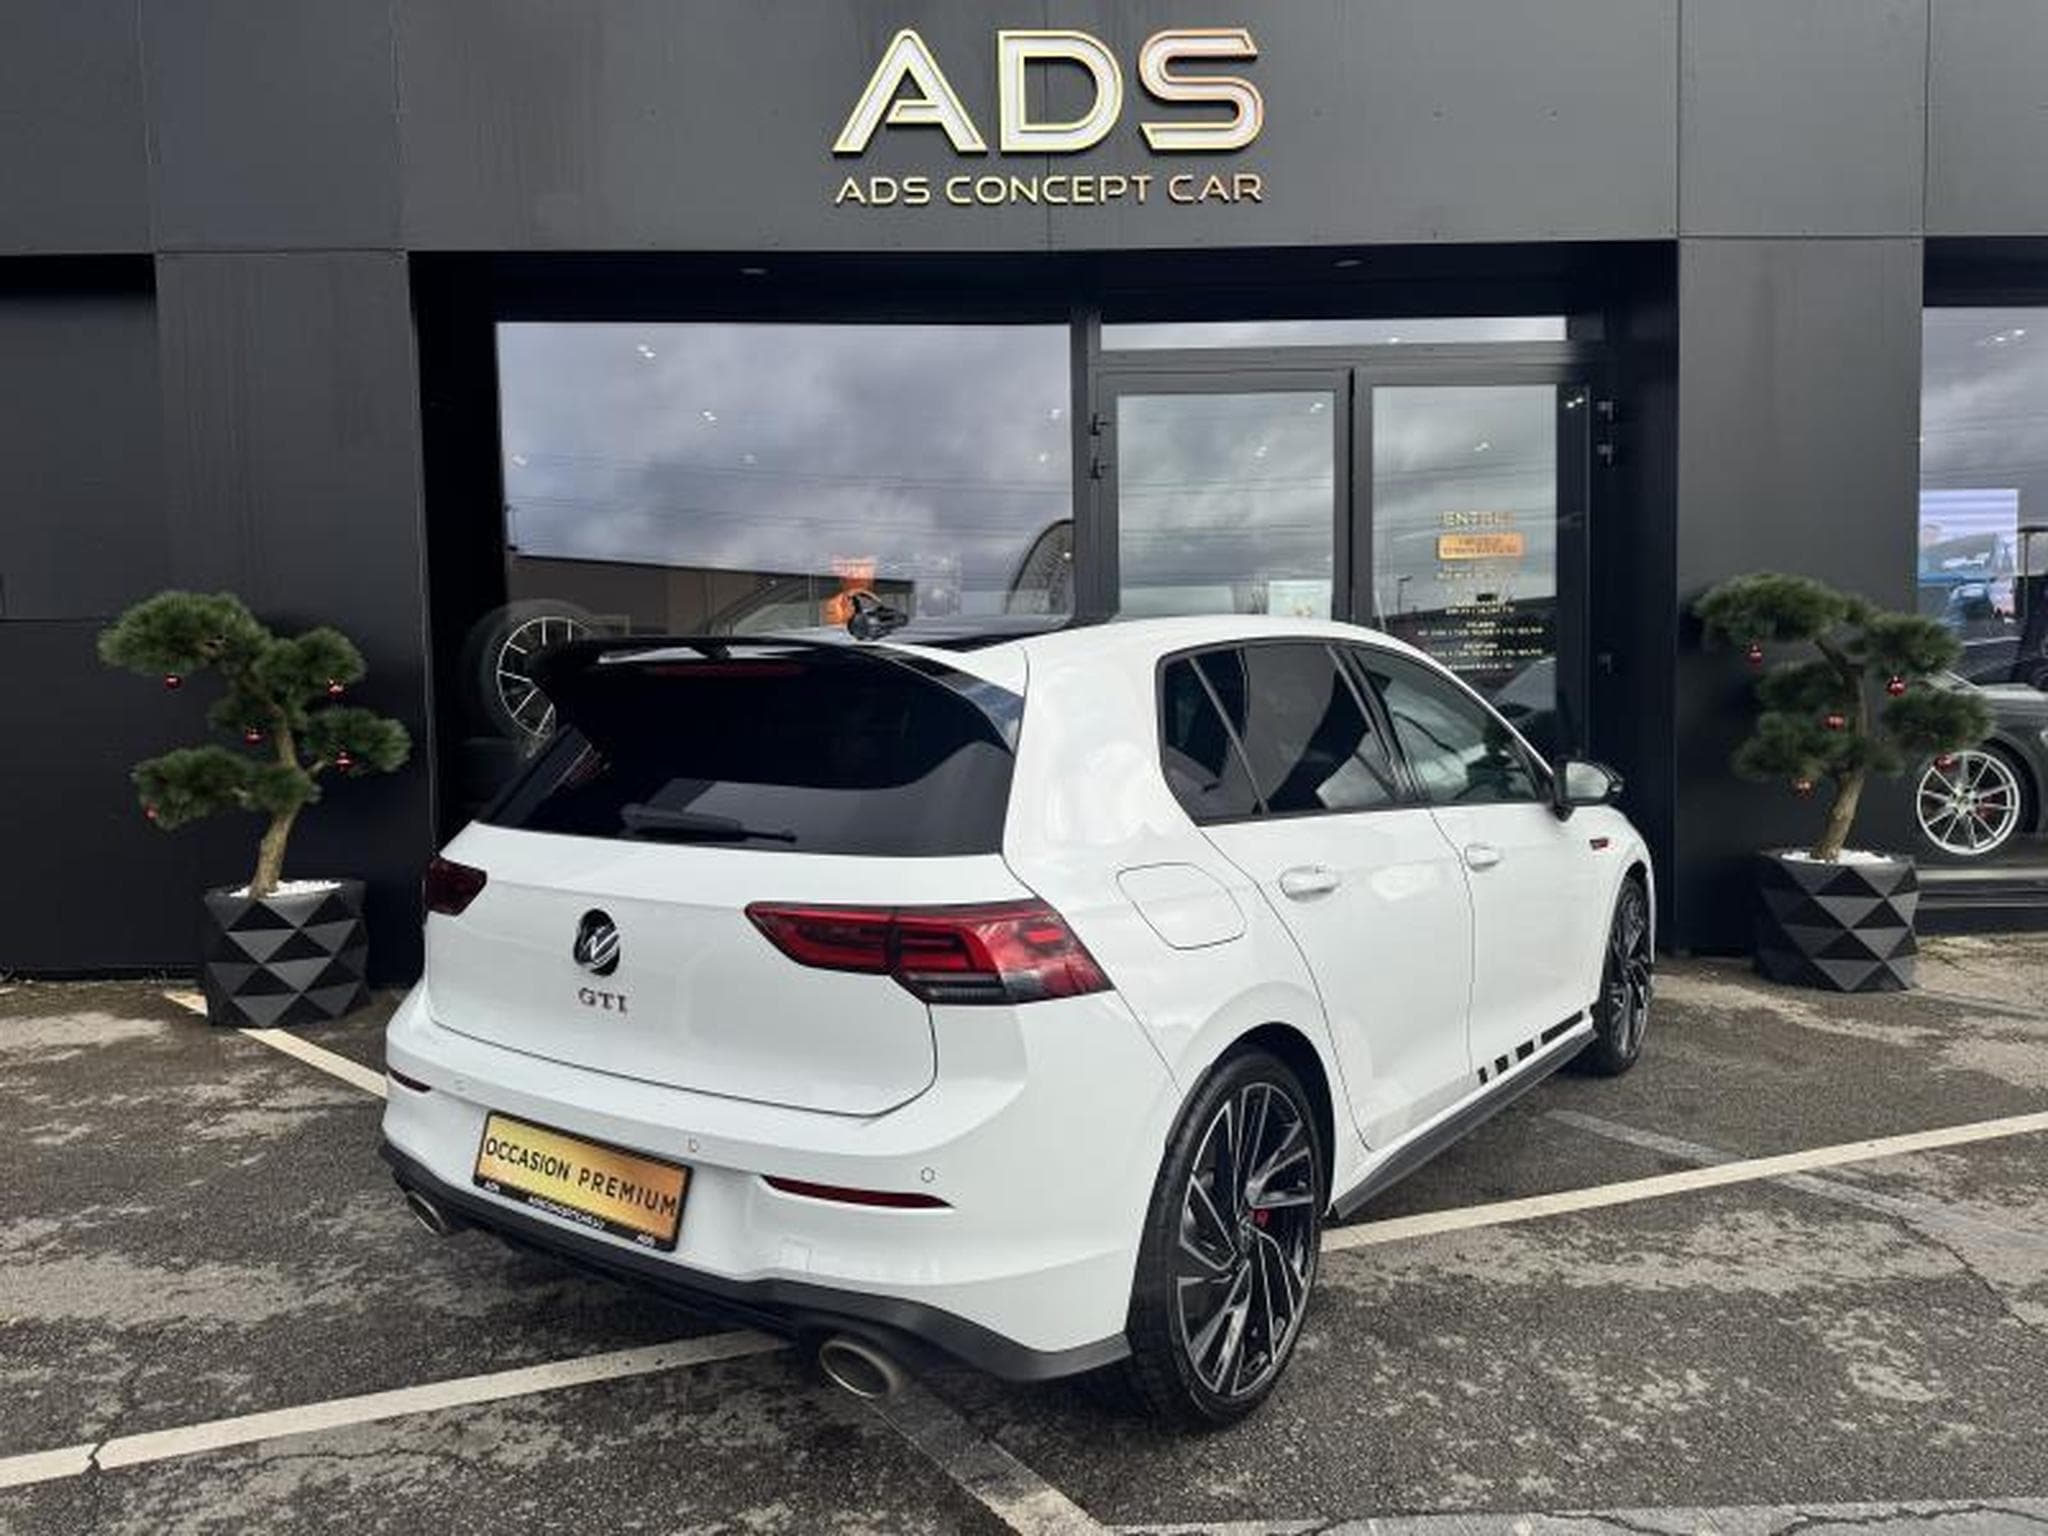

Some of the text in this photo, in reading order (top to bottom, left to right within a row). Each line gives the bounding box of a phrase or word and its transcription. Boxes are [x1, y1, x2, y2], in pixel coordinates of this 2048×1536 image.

[832, 27, 1265, 155] ADS
[834, 173, 1264, 206] ADS CONCEPT CAR
[578, 986, 628, 1014] GTI
[485, 1136, 572, 1181] OCCASION
[577, 1165, 677, 1217] PREMIUM
